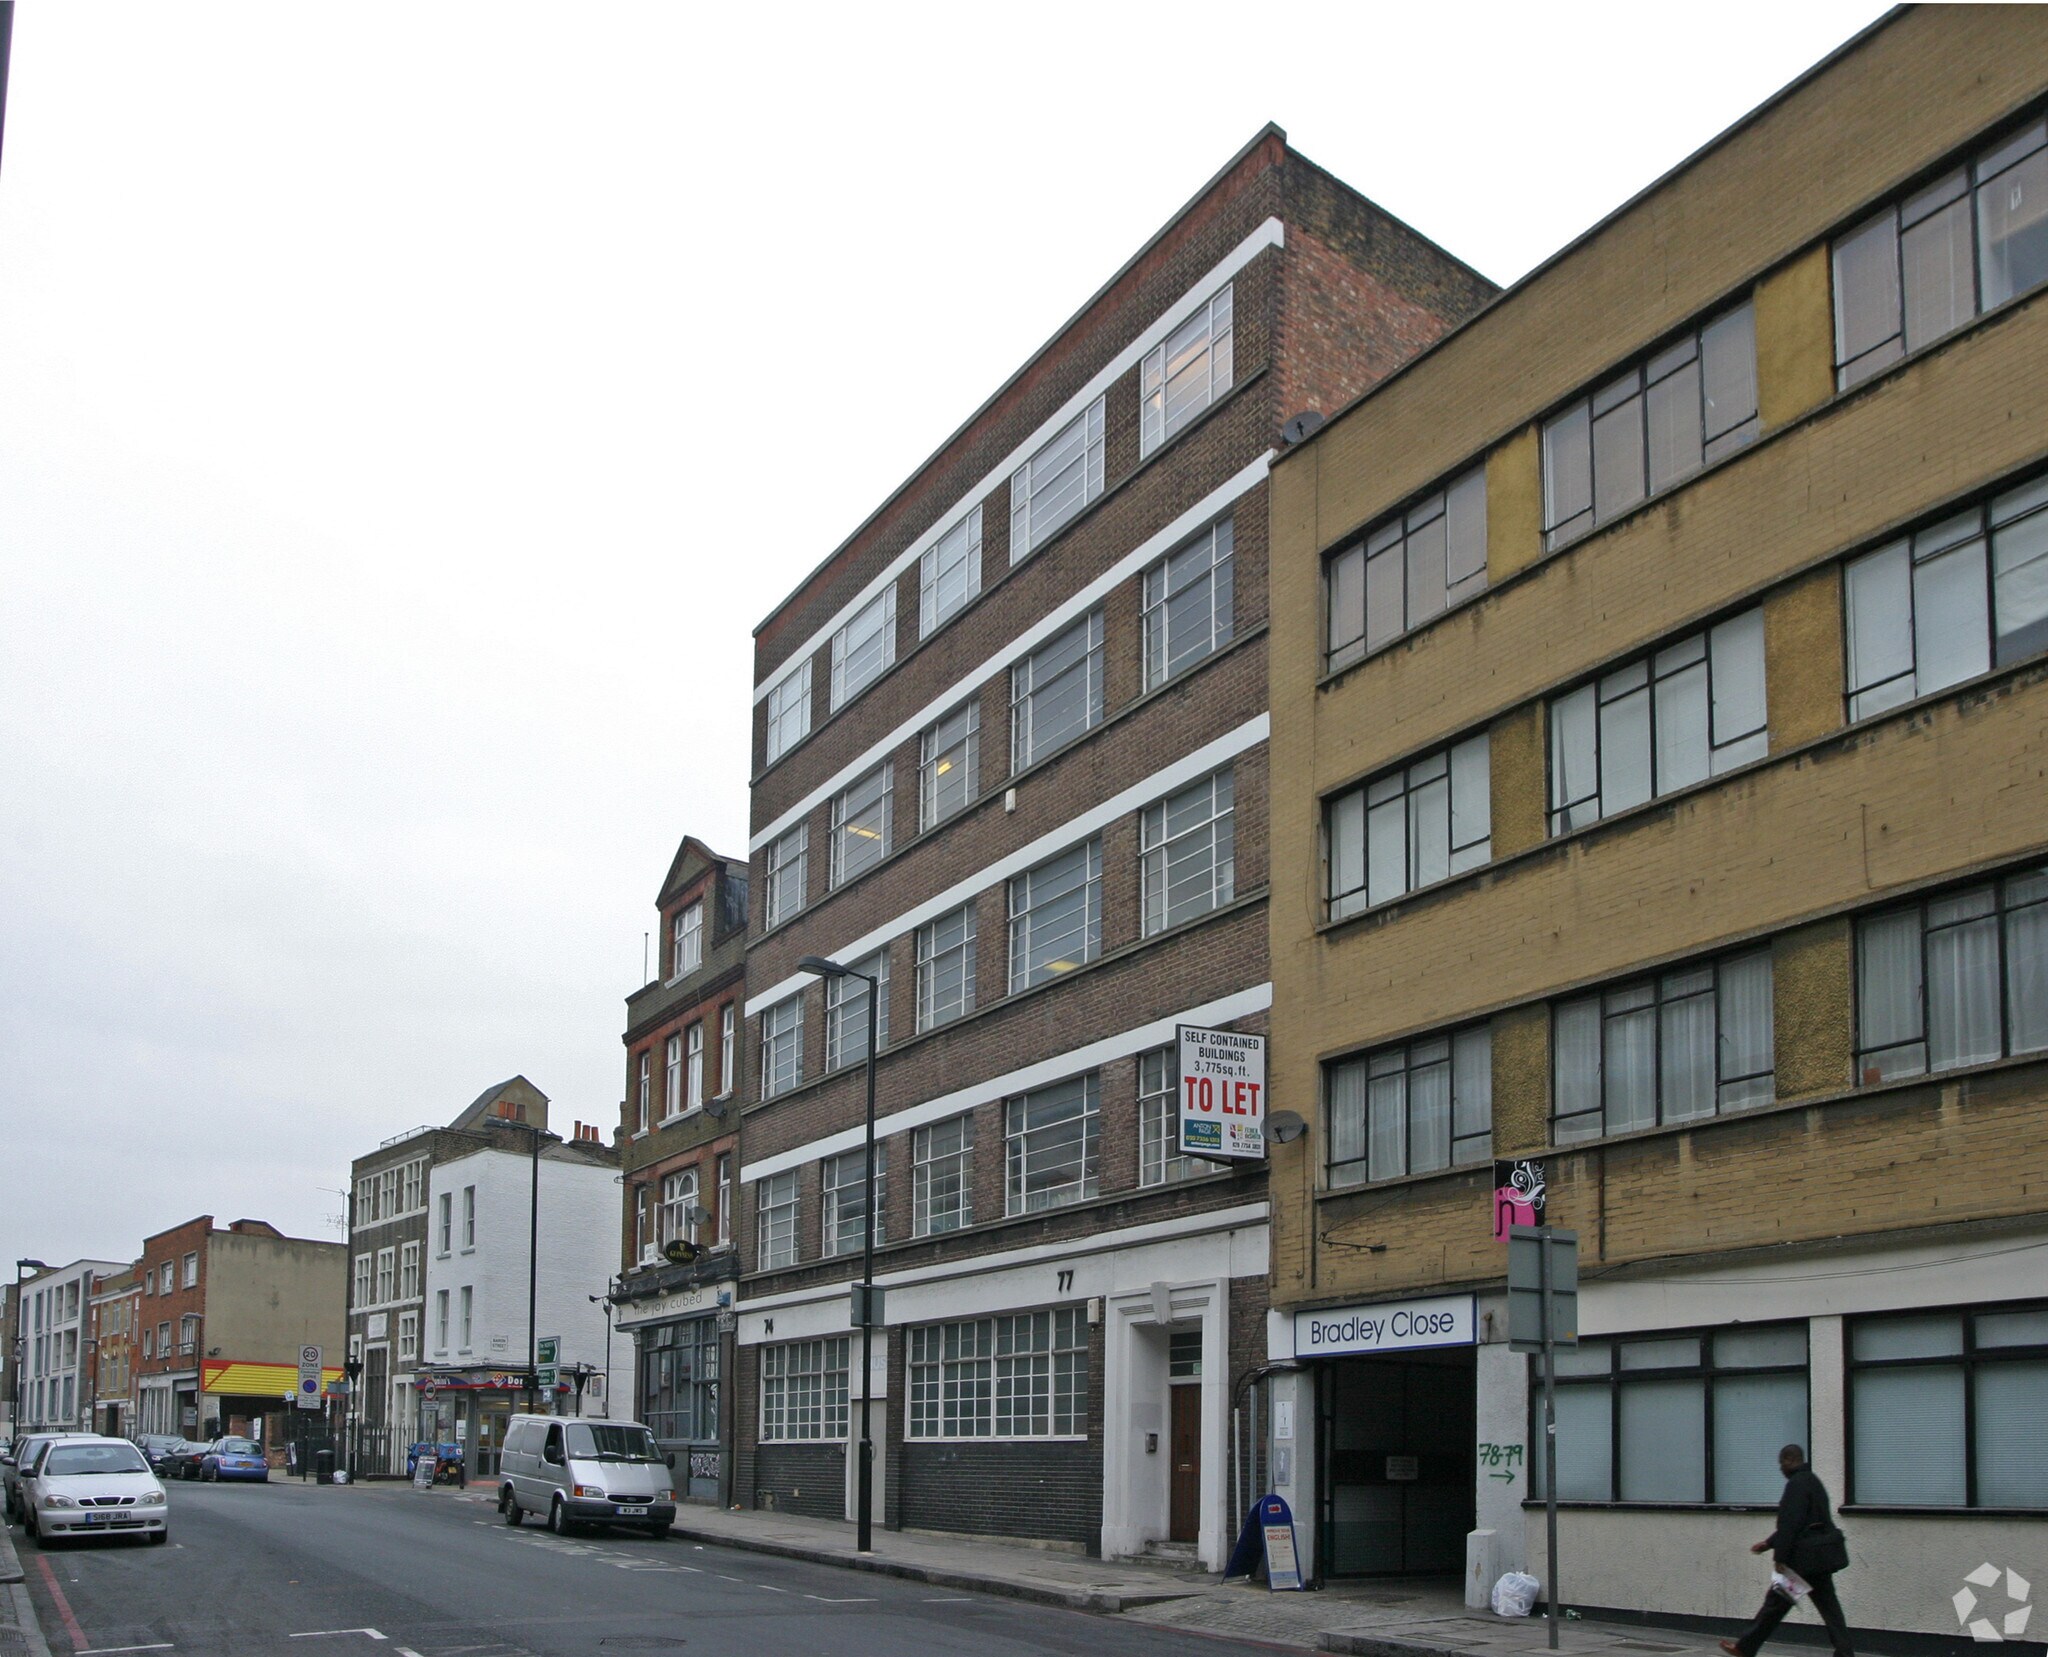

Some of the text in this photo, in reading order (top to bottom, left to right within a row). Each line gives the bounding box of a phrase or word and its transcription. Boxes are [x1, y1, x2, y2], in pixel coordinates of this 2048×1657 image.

[1184, 1031, 1259, 1050] SELF CONTAINED
[1198, 1047, 1246, 1063] BUILDINGS
[1194, 1060, 1250, 1077] 3,775sq.ft.
[1184, 1076, 1261, 1116] TO LET
[1057, 1269, 1074, 1293] 77
[671, 1291, 702, 1309] cubed
[764, 1318, 774, 1335] 74
[1311, 1310, 1455, 1345] Bradley Close
[305, 1350, 316, 1358] 20
[1479, 1443, 1524, 1467] 78-79
[112, 1512, 128, 1520] JRA
